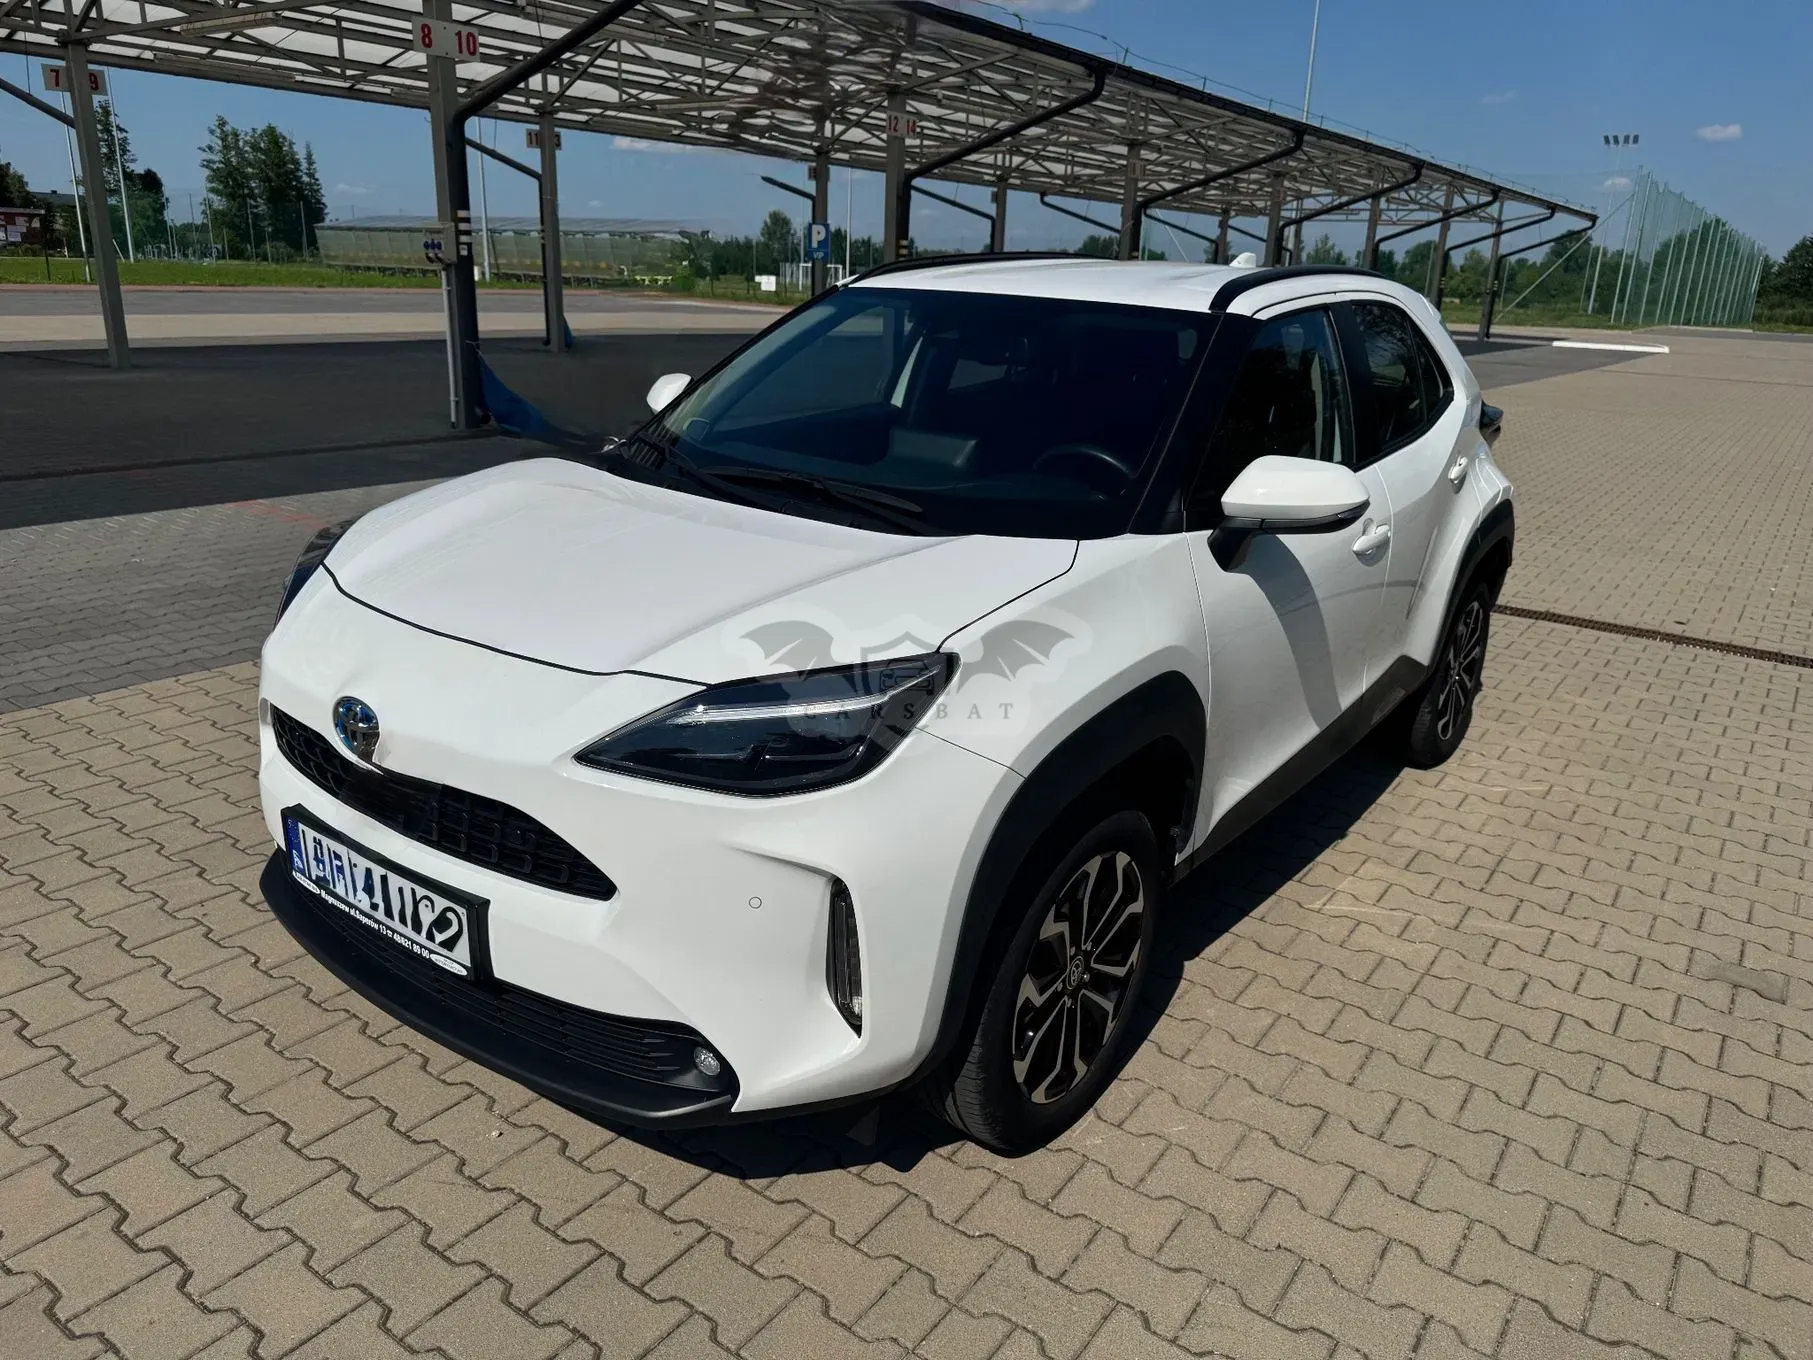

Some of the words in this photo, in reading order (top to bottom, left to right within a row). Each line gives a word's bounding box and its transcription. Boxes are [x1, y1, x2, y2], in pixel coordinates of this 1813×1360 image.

[420, 23, 433, 49] 8
[455, 30, 477, 56] 10
[49, 68, 60, 88] 7
[88, 72, 99, 91] 9
[888, 114, 899, 133] 12
[811, 224, 826, 249] P
[379, 923, 386, 936] 13
[421, 946, 430, 959] 00
